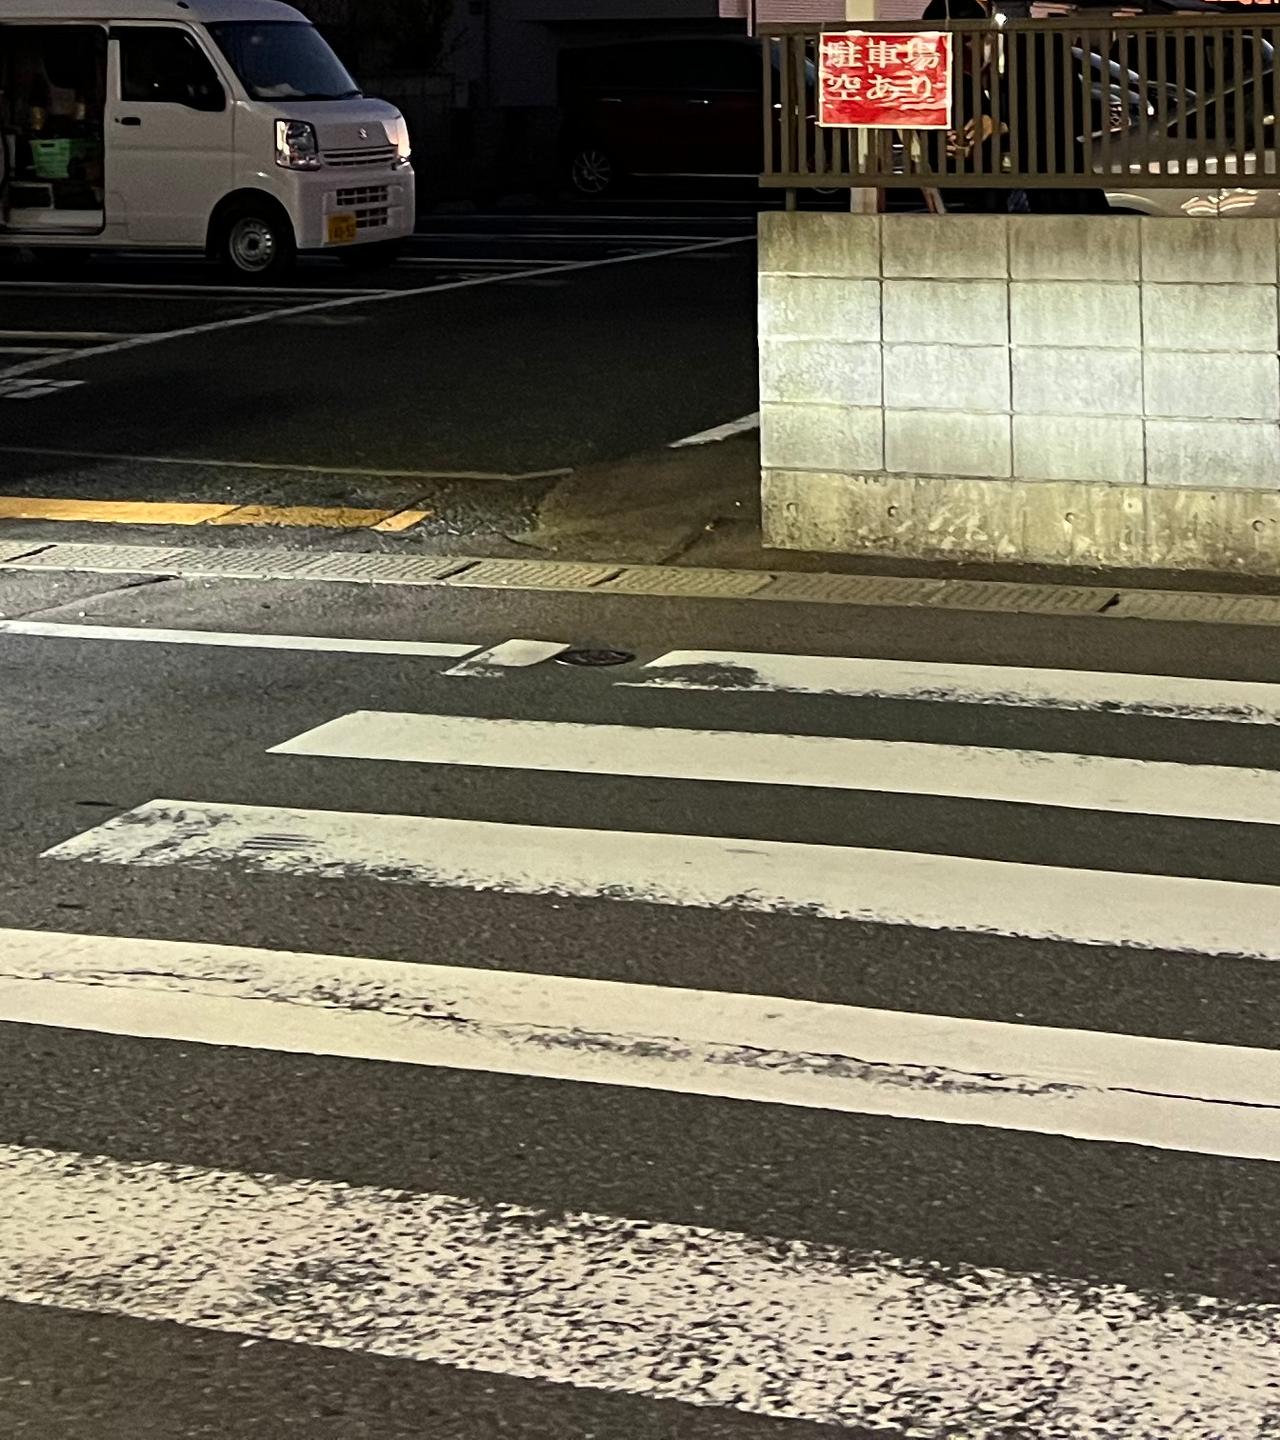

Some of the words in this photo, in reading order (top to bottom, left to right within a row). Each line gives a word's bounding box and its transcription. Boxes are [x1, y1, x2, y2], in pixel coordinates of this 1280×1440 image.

[822, 37, 941, 71] 駐車場
[826, 73, 933, 101] 空あり
